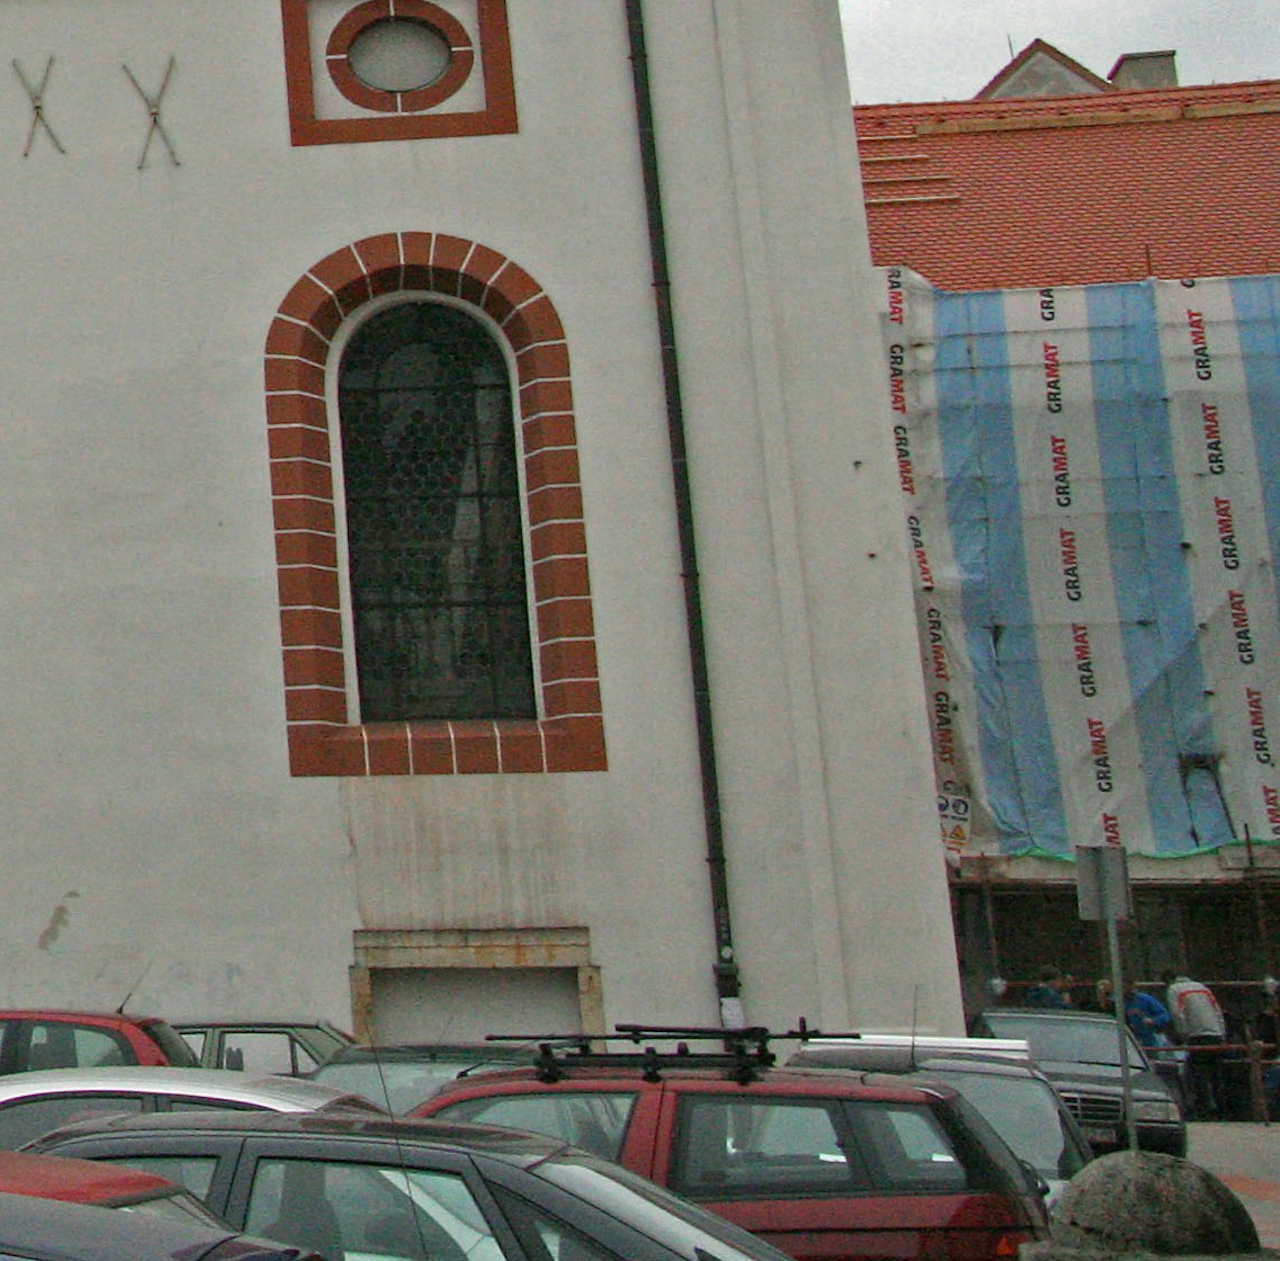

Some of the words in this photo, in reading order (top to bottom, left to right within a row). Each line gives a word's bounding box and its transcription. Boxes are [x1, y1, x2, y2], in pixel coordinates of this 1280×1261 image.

[890, 344, 907, 414] GRAMAT
[1044, 342, 1062, 414] GRAMAT
[1187, 309, 1212, 381] GRAMAT
[893, 425, 916, 496] GRAMAT
[1050, 435, 1073, 508] GRAMAT
[1201, 402, 1226, 476] GRAMAT
[907, 515, 935, 587] GRAMAT
[1059, 527, 1082, 602] GRAMAT
[1214, 496, 1239, 571] GRAMAT
[926, 607, 951, 682] GRAMAT
[1071, 623, 1097, 698] GRAMAT
[1228, 590, 1255, 666] GRAMAT
[933, 690, 955, 765] GRAMAT
[1086, 717, 1113, 793] GRAMAT
[1246, 687, 1272, 765] GRAMAT
